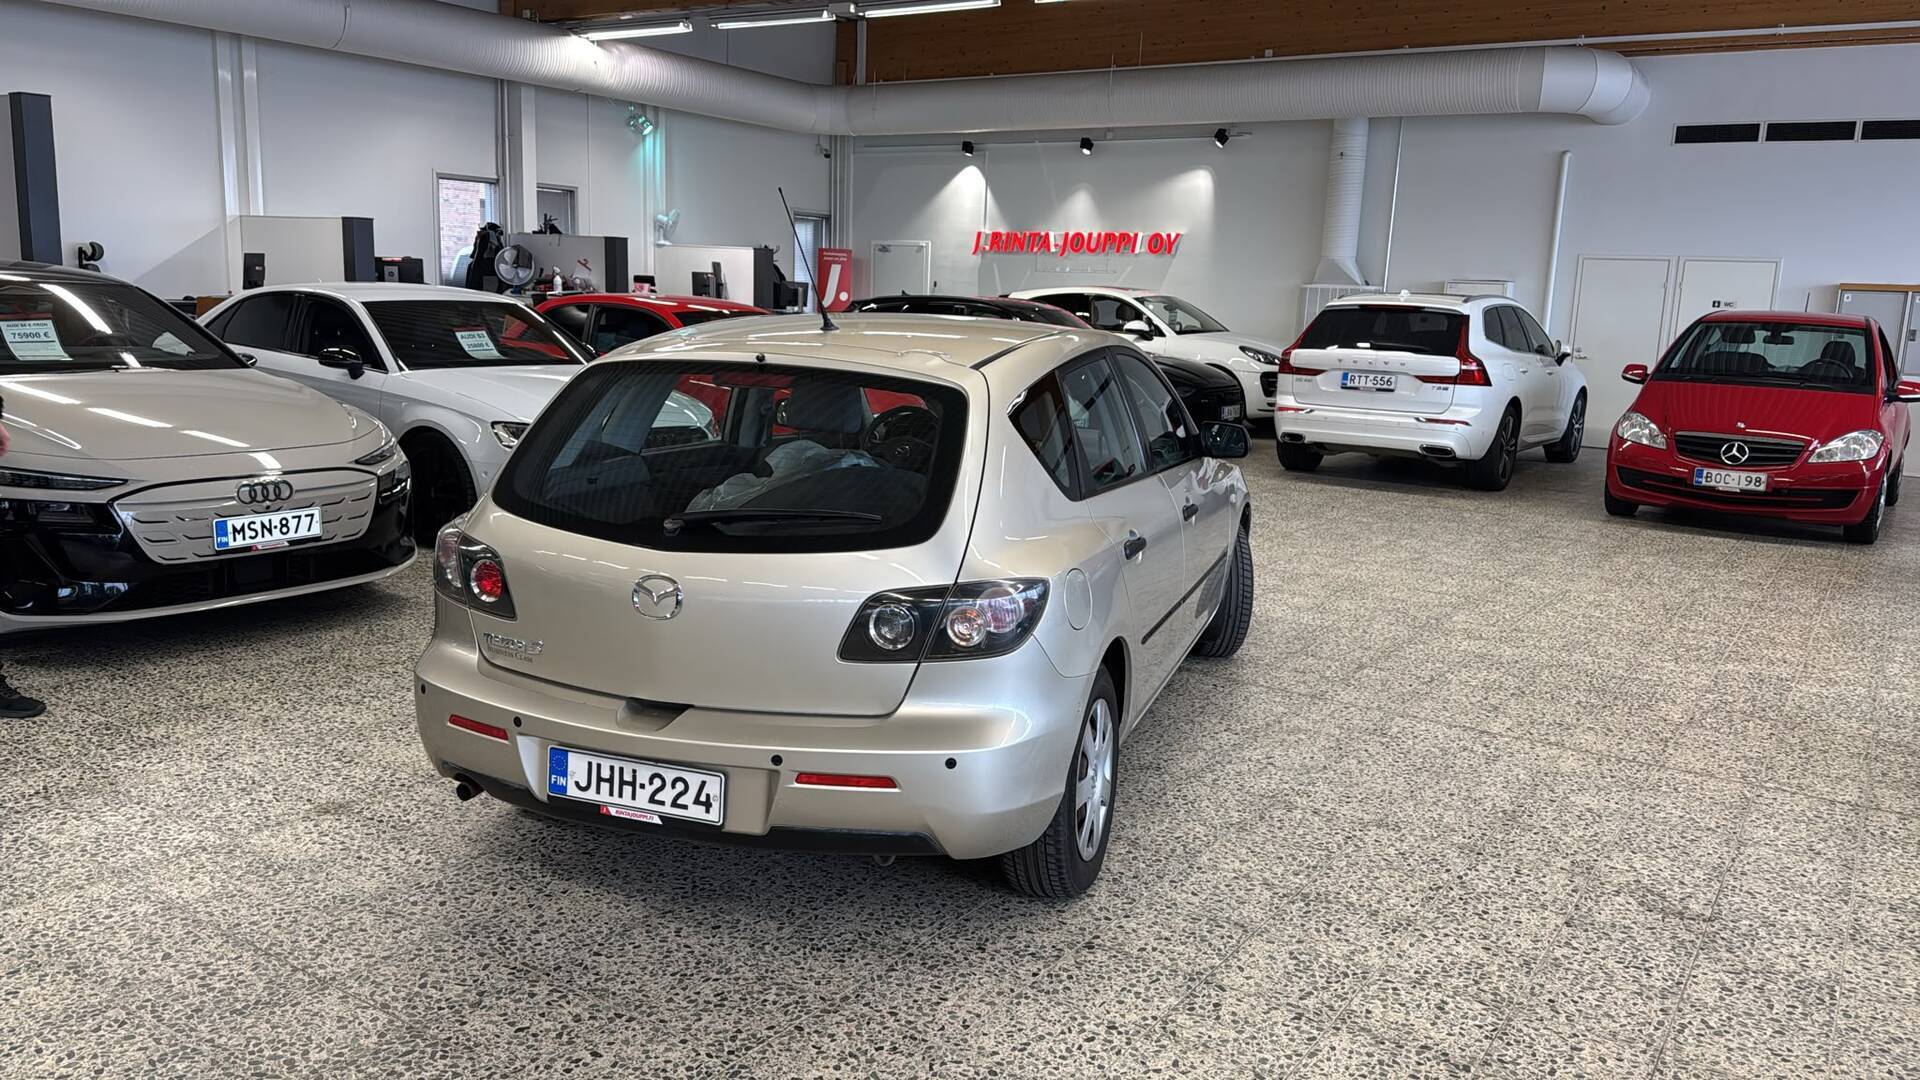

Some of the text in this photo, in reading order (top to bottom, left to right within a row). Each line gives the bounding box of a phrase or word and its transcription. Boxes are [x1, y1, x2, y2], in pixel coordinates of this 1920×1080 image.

[1146, 232, 1182, 255] OY
[10, 331, 51, 339] 75900 €
[1349, 374, 1394, 387] RTT-556
[1704, 471, 1763, 488] BOC-198
[231, 513, 315, 542] MSN-877
[217, 536, 229, 544] FIN
[551, 774, 567, 787] FIN
[574, 760, 714, 815] JHH-224
